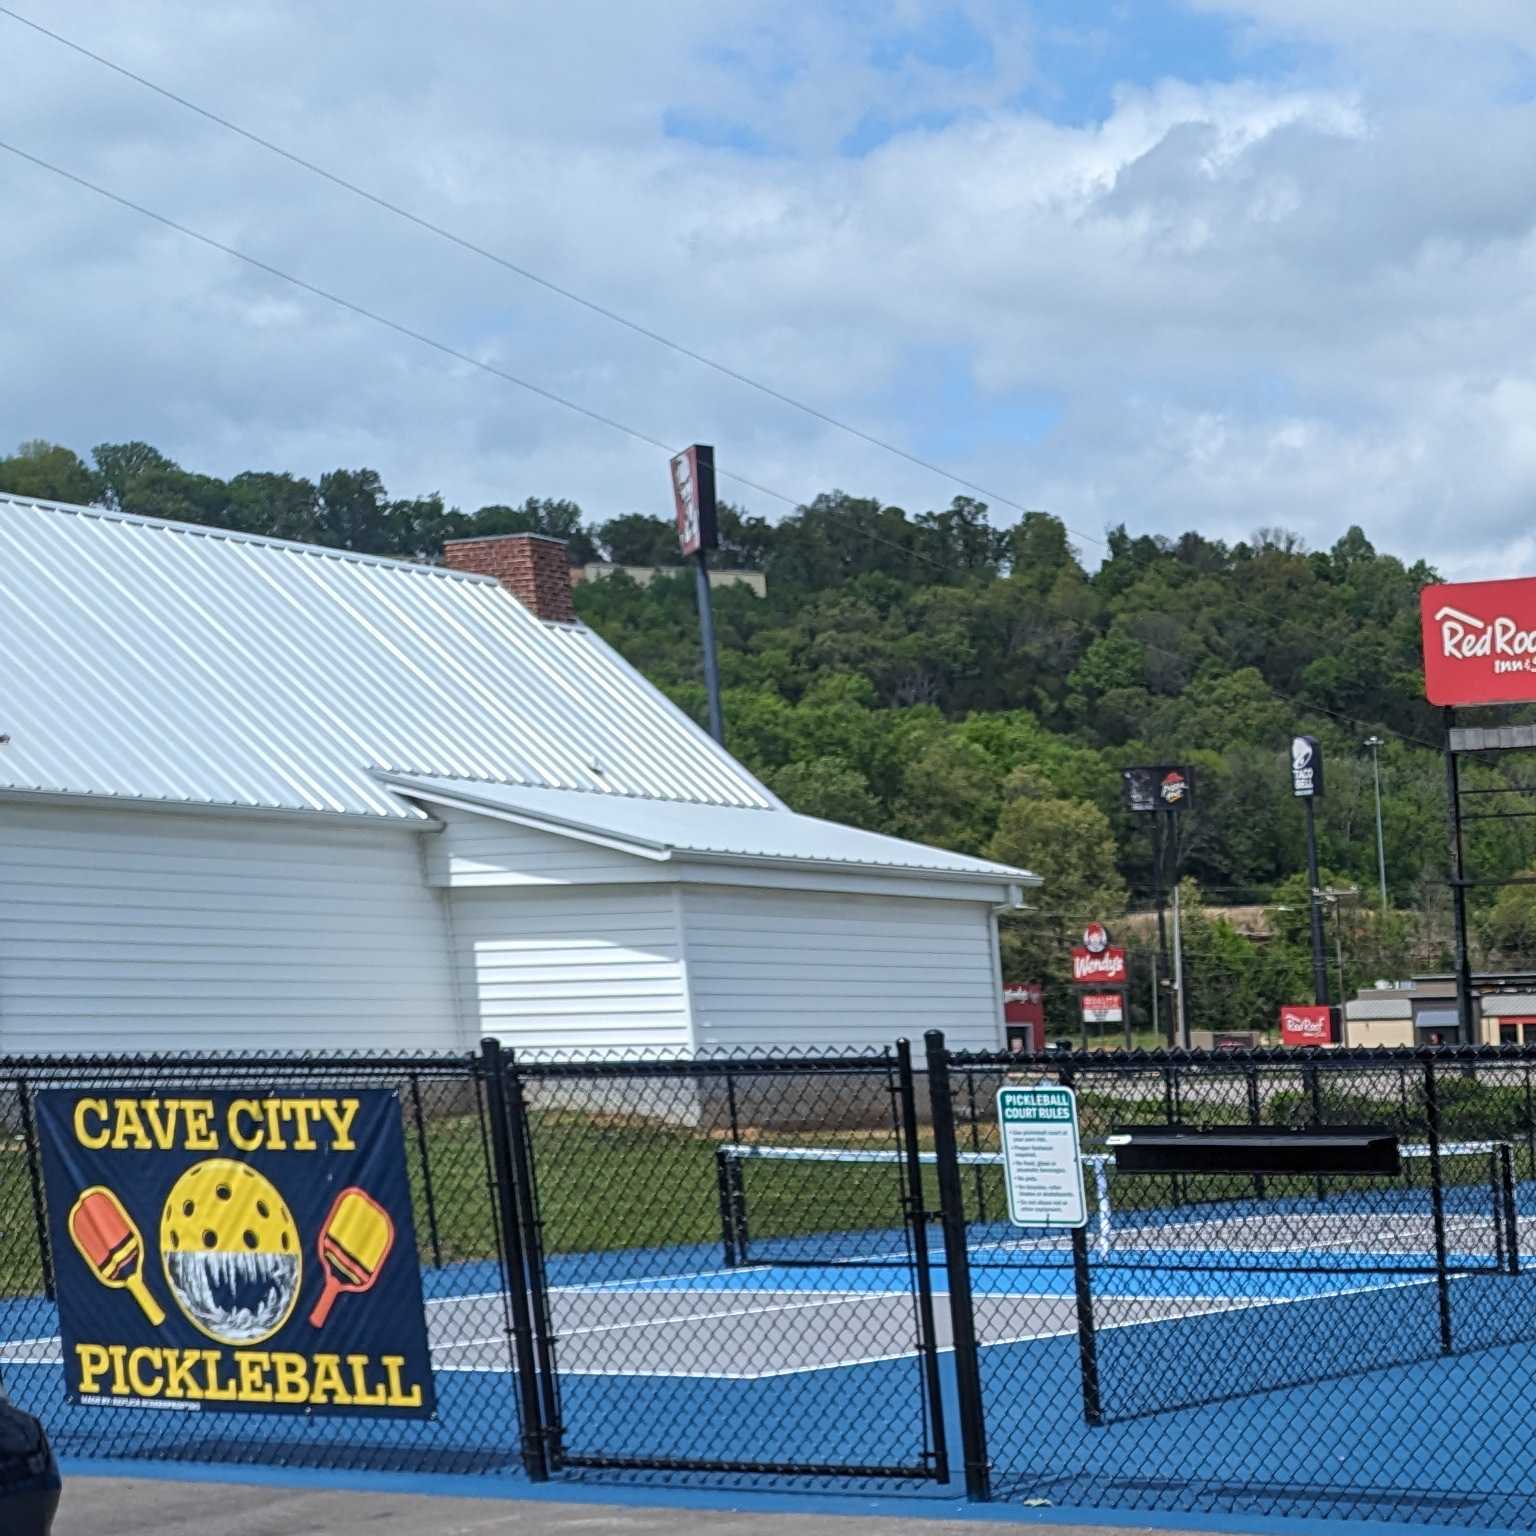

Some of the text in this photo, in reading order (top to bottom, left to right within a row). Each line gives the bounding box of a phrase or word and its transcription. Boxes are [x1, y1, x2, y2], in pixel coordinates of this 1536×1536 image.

[1442, 619, 1493, 660] Red
[1292, 767, 1314, 780] TACO
[1004, 1093, 1070, 1106] PICKLEBALL
[1004, 1107, 1071, 1119] COURT RULES
[73, 1097, 360, 1151] CAVE CITY
[75, 1343, 423, 1408] PICKLEBALL
